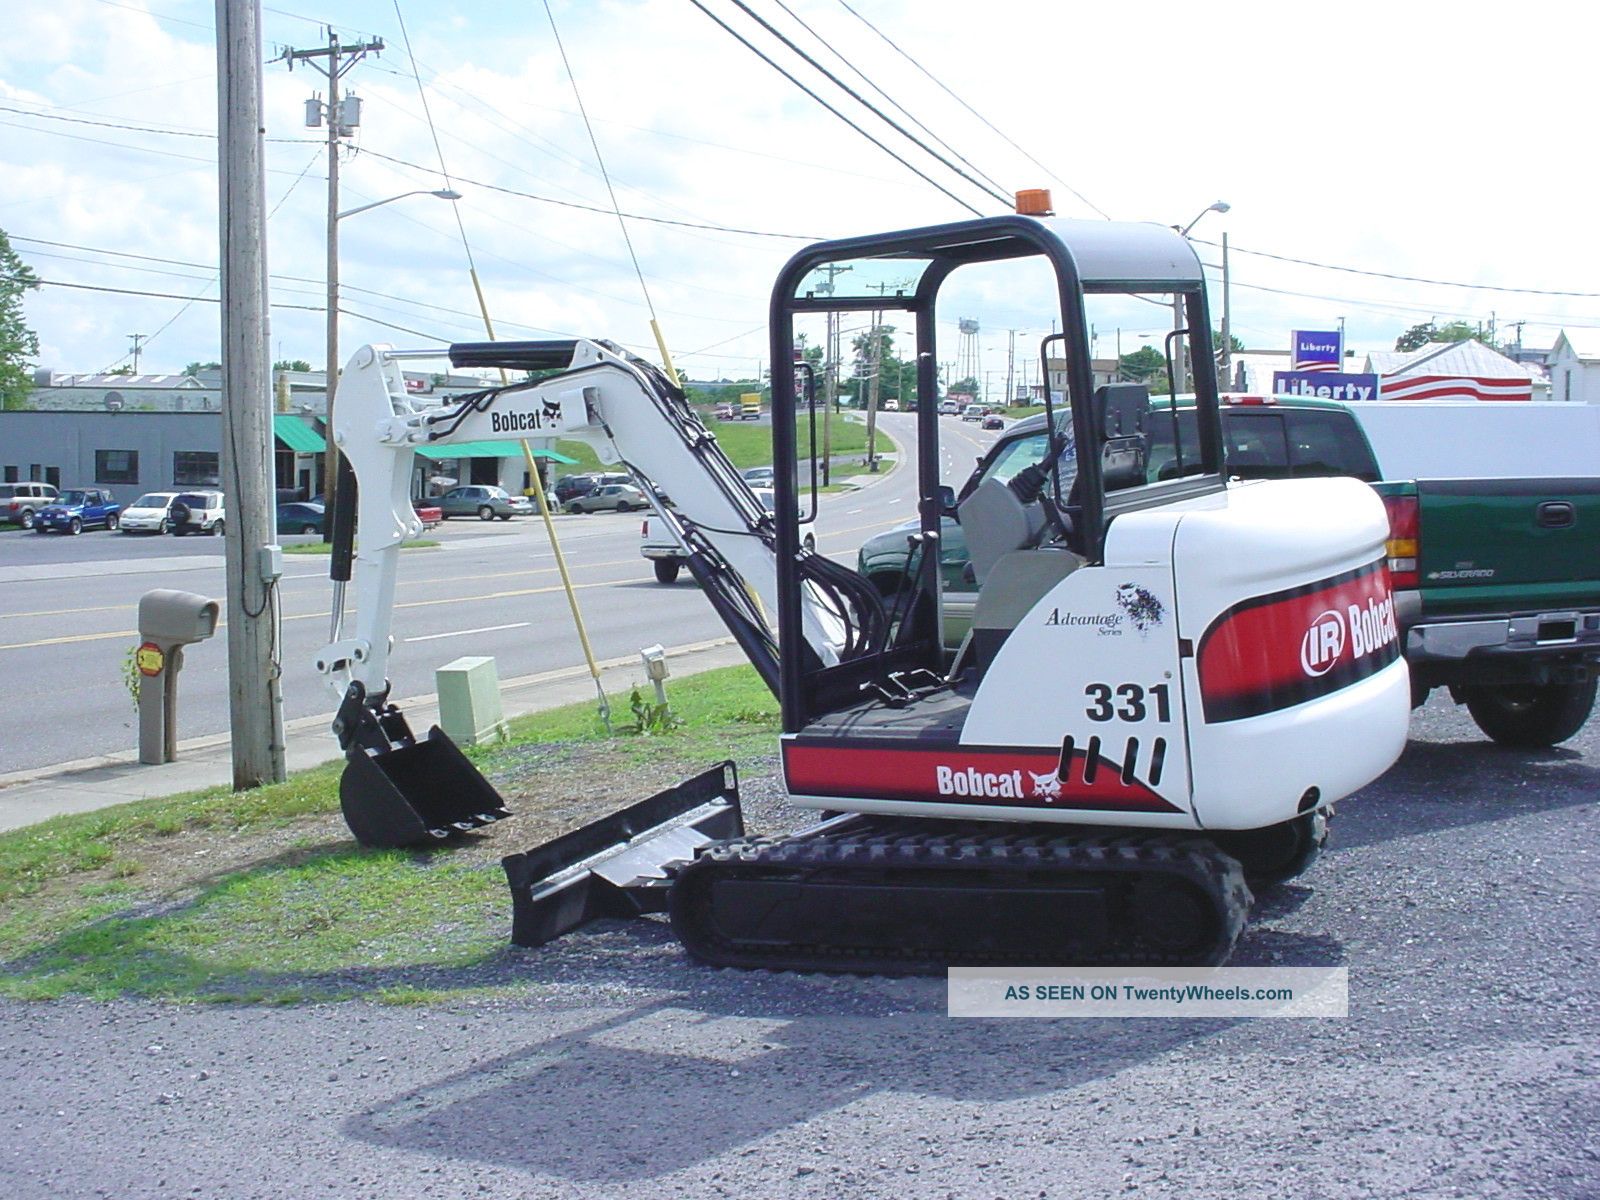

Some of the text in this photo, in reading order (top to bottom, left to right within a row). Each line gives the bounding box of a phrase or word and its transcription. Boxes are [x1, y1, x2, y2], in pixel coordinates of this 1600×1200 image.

[1300, 342, 1336, 353] Liberty
[1277, 379, 1372, 400] Liberty
[491, 408, 541, 432] Bobcat
[1440, 569, 1495, 579] SILVERADO
[1045, 607, 1123, 628] Advantage
[1347, 589, 1397, 659] Bobcat
[1097, 627, 1122, 636] Series
[1085, 683, 1171, 723] 331
[936, 765, 1024, 798] Bobcat
